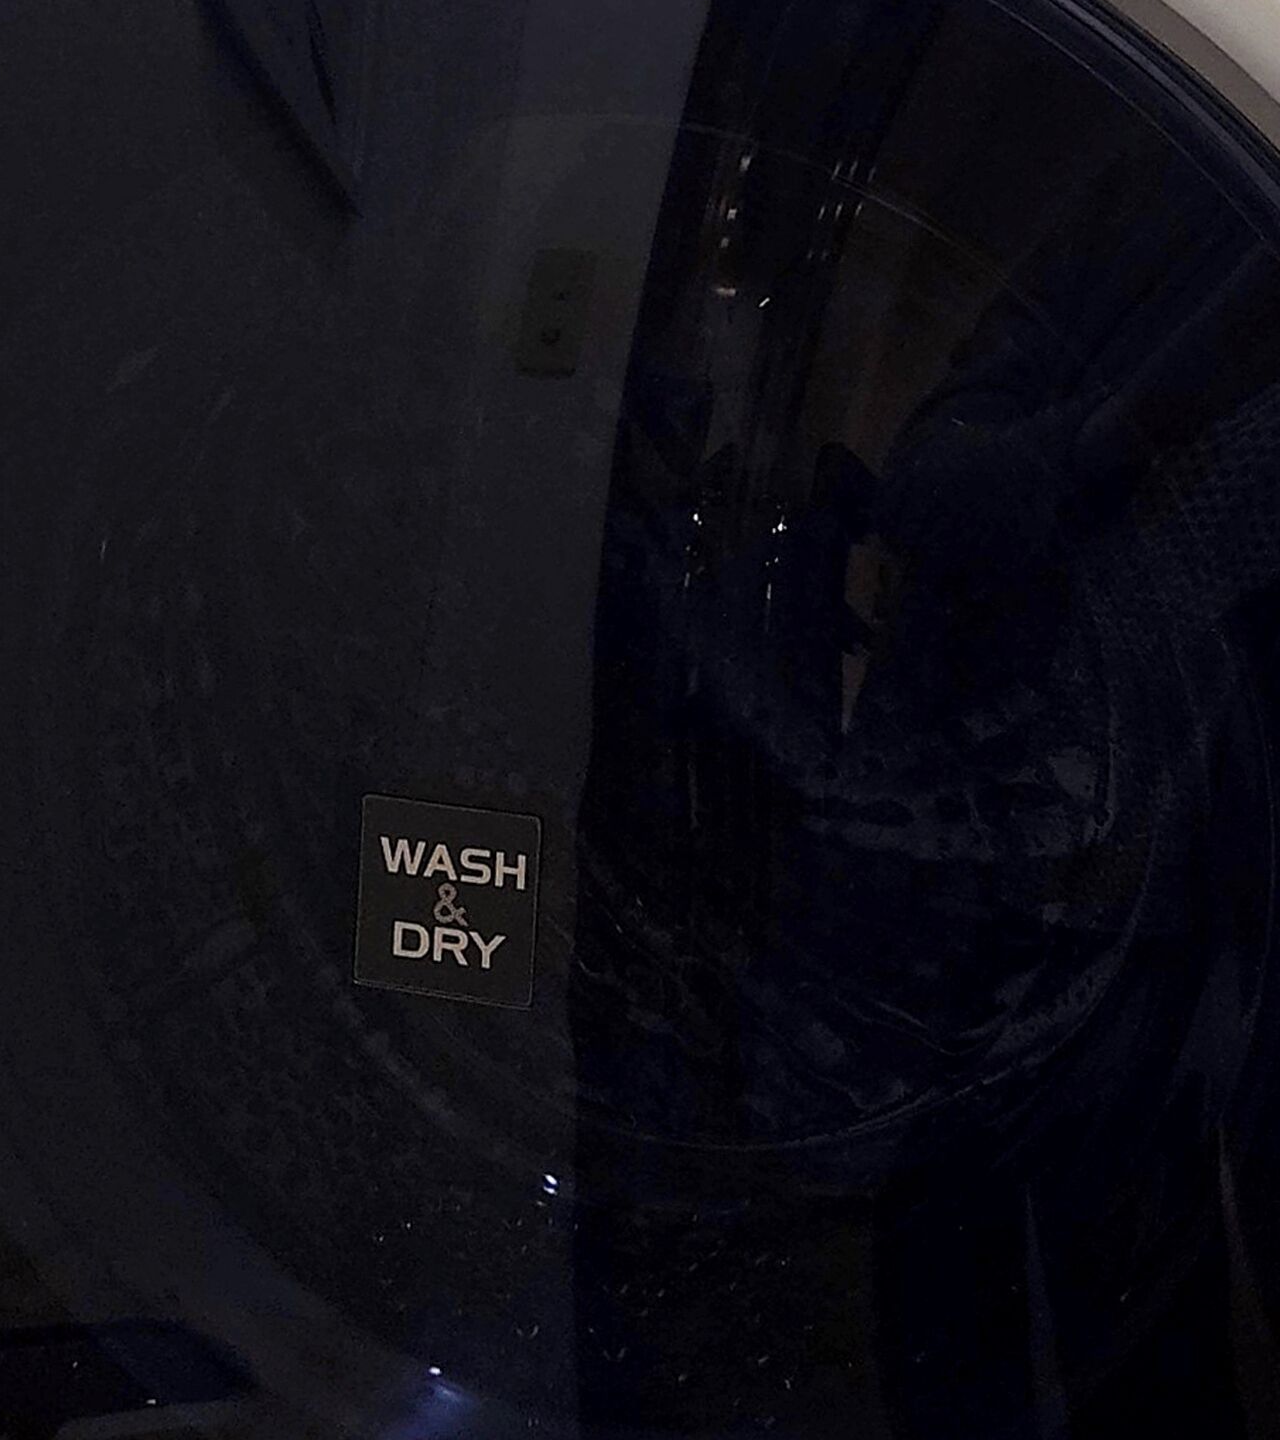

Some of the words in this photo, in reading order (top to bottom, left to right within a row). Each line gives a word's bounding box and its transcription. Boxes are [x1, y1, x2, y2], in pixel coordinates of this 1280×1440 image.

[379, 835, 527, 891] WASH
[433, 882, 469, 928] &
[392, 920, 507, 970] DRY
